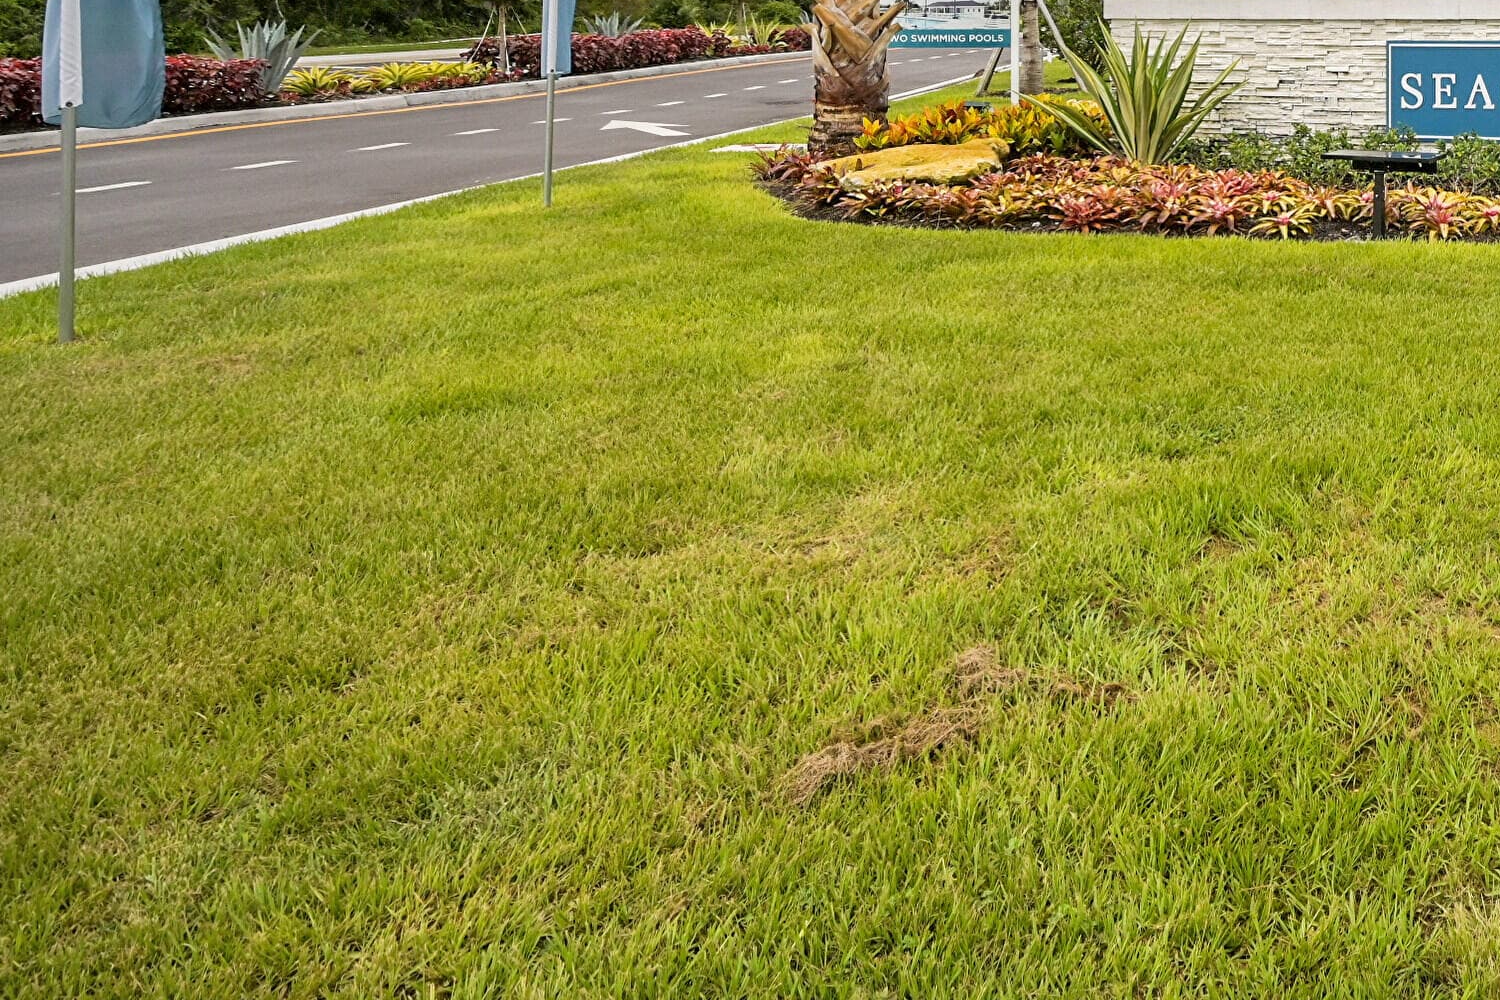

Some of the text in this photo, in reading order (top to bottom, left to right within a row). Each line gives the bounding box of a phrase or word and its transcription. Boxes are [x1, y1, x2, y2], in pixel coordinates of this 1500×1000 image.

[890, 34, 1004, 43] WO SWIMMING POOLS
